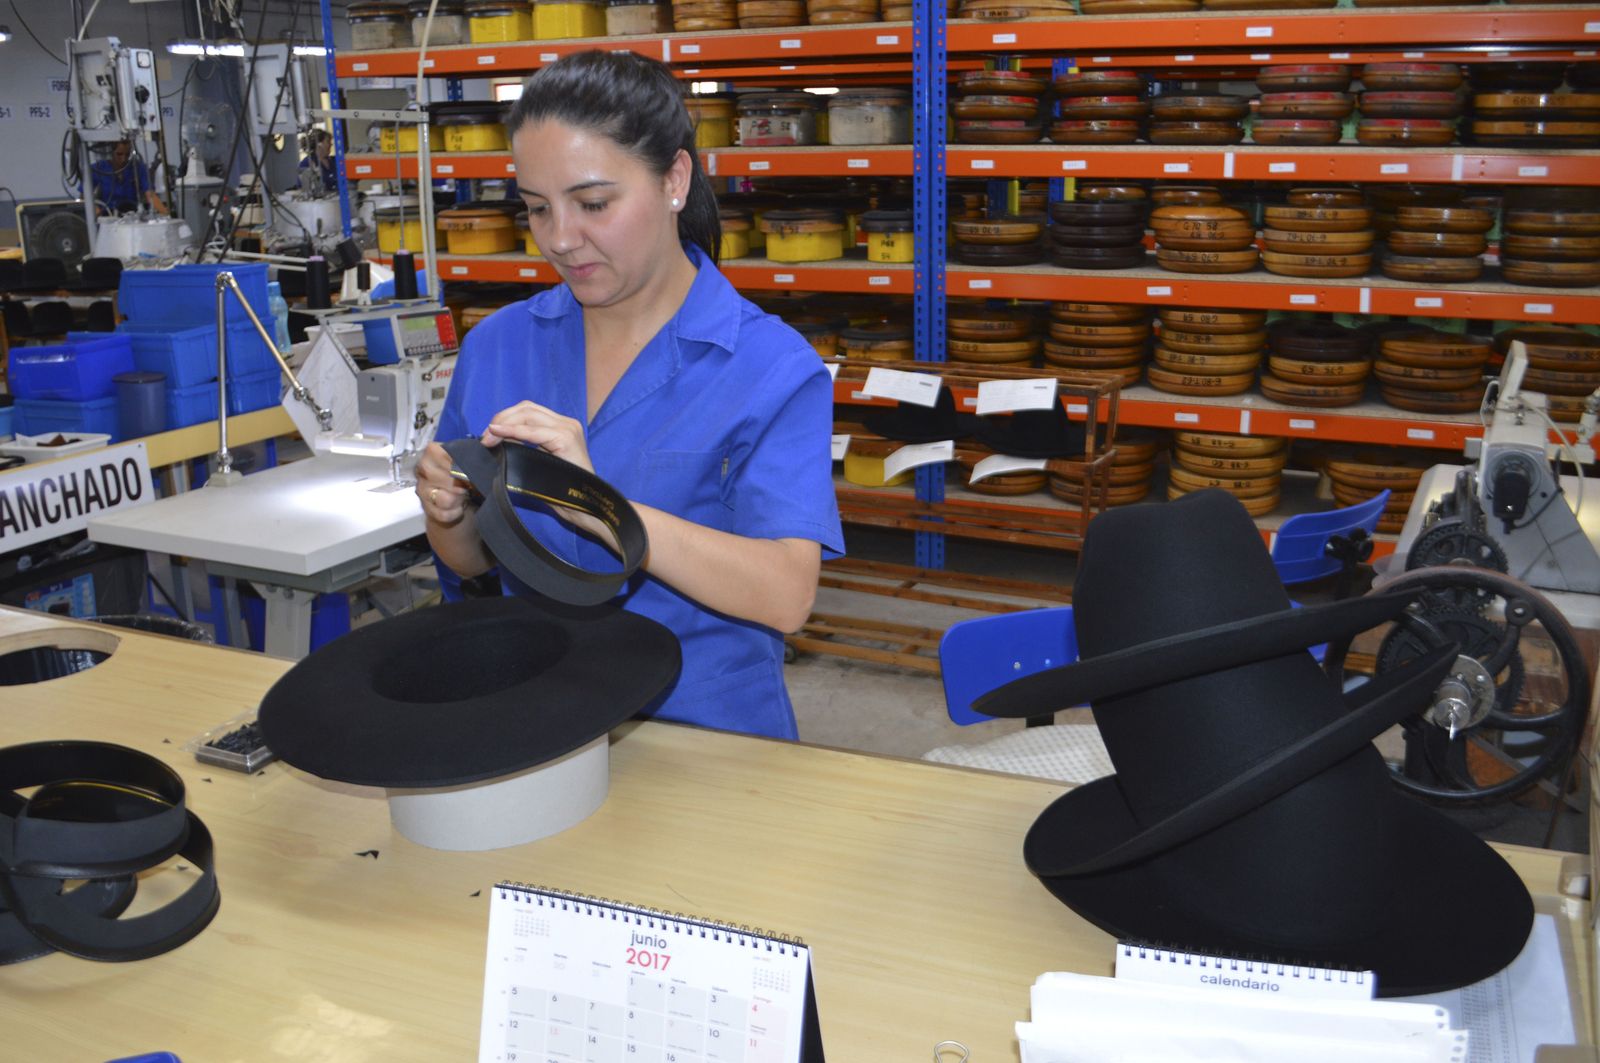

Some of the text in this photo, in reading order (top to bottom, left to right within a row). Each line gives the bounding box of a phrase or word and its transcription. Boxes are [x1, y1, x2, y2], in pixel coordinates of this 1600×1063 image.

[630, 930, 667, 949] junio
[625, 947, 671, 971] 2017
[1200, 972, 1280, 992] calendario
[670, 986, 676, 994] 2
[552, 994, 558, 1002] 6
[509, 1020, 518, 1029] 12
[709, 1028, 720, 1038] 10
[588, 1035, 597, 1044] 14
[627, 1044, 636, 1053] 15
[507, 1053, 517, 1061] 19
[667, 1053, 676, 1062] 16
